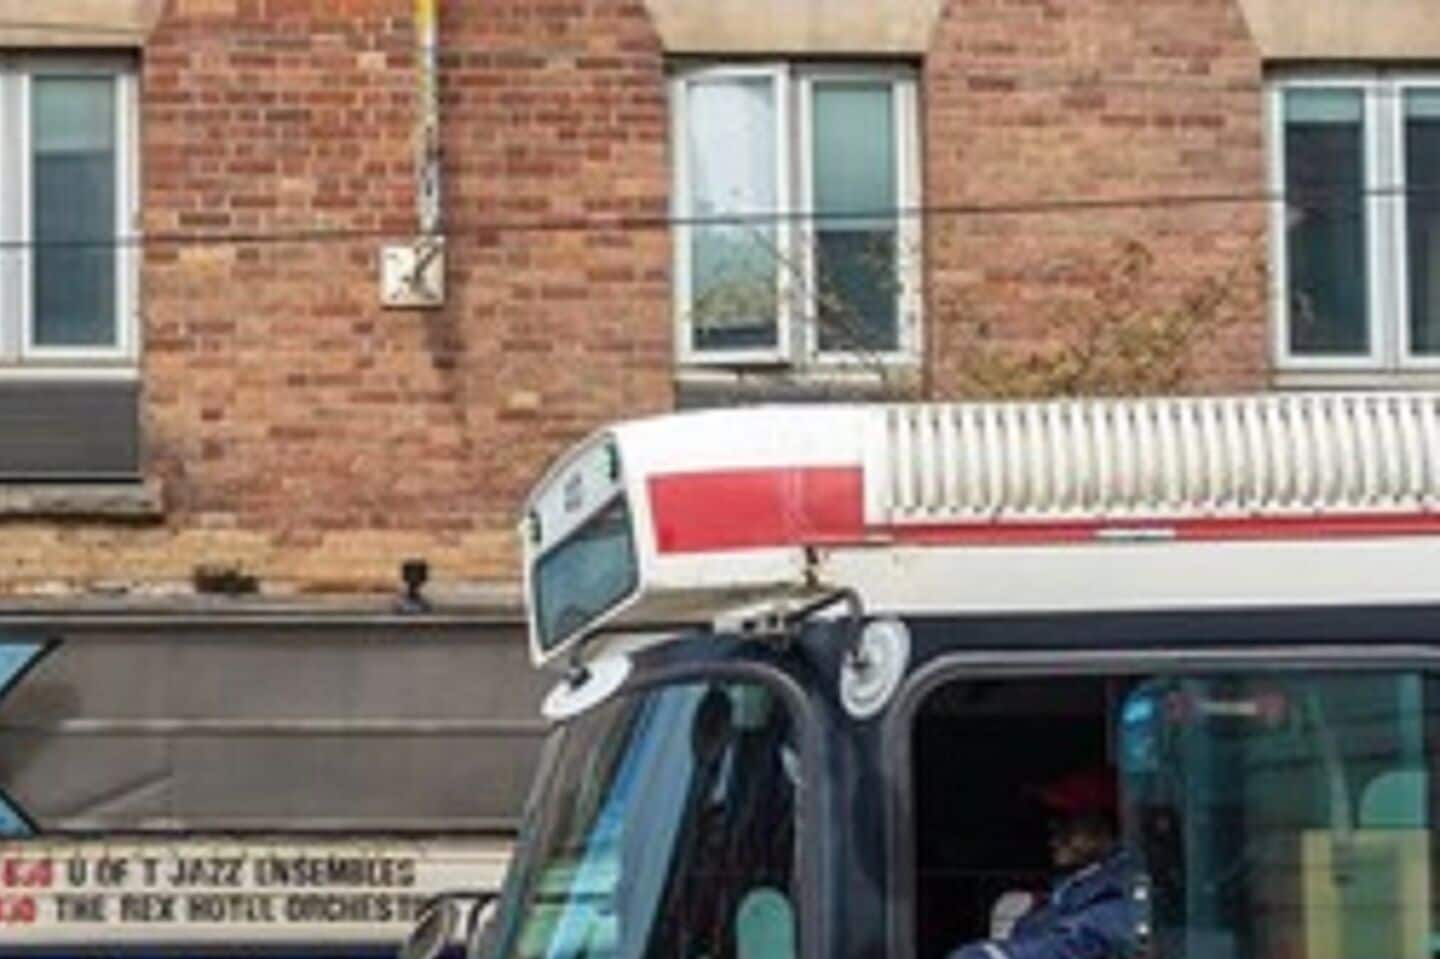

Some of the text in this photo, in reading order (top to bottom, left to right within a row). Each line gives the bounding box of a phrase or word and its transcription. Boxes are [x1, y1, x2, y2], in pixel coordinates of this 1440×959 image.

[67, 858, 87, 887] U
[95, 858, 128, 887] OF
[141, 857, 160, 887] T
[168, 857, 243, 887] JAZZ
[253, 857, 416, 887] ENSEMBLES
[54, 894, 107, 923] THE
[119, 894, 174, 923] REX
